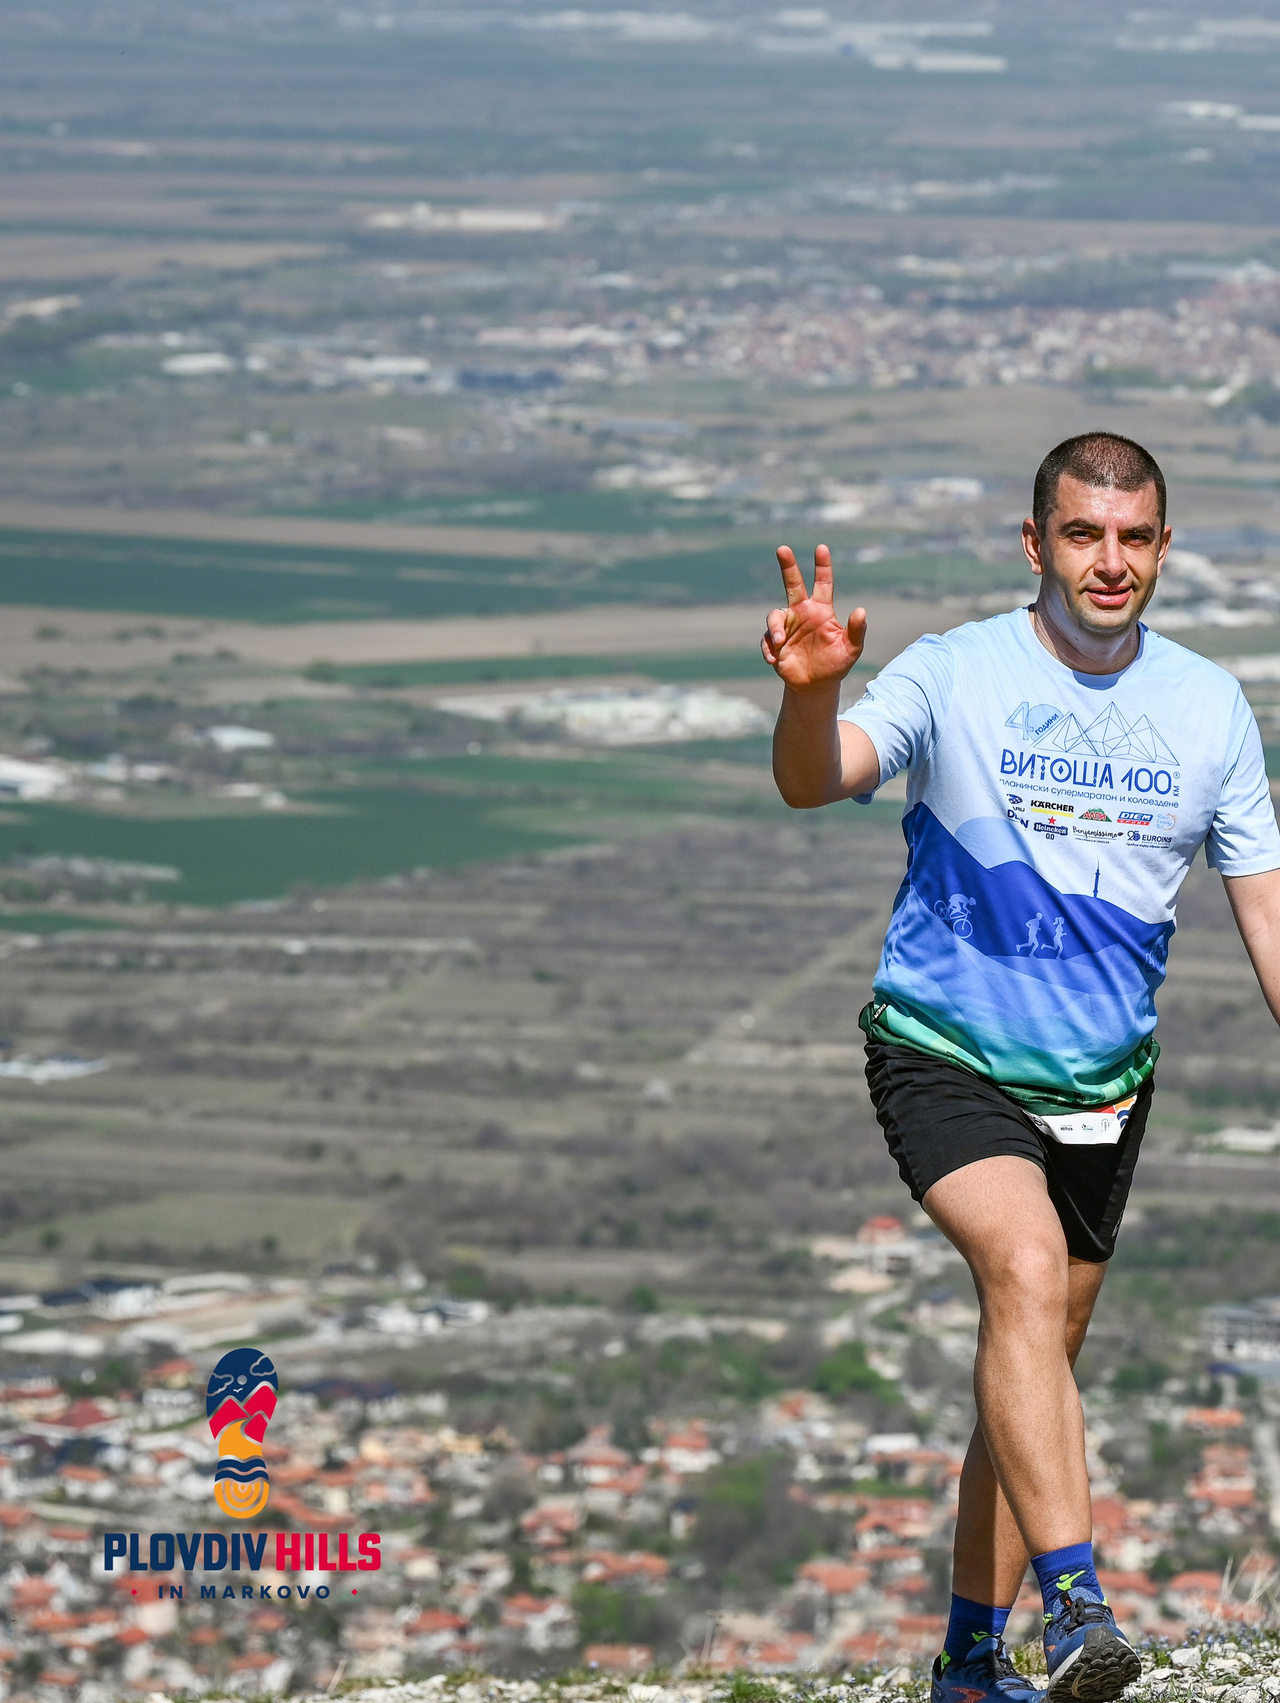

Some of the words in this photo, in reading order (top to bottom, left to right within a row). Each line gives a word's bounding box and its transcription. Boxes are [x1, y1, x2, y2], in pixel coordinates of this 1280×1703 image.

[1034, 713, 1060, 736] ГОДИНИ
[1000, 748, 1114, 790] ВИТОША
[1120, 766, 1172, 796] 100
[999, 778, 1050, 793] планински
[1051, 787, 1117, 802] супермаратон
[1127, 797, 1179, 809] колоездене
[1030, 799, 1075, 813] KÄRCHER
[1120, 812, 1151, 821] DIEM
[1035, 823, 1067, 834] Heineken
[1072, 825, 1118, 839] Benjamissimo
[1141, 834, 1172, 843] EUROINS
